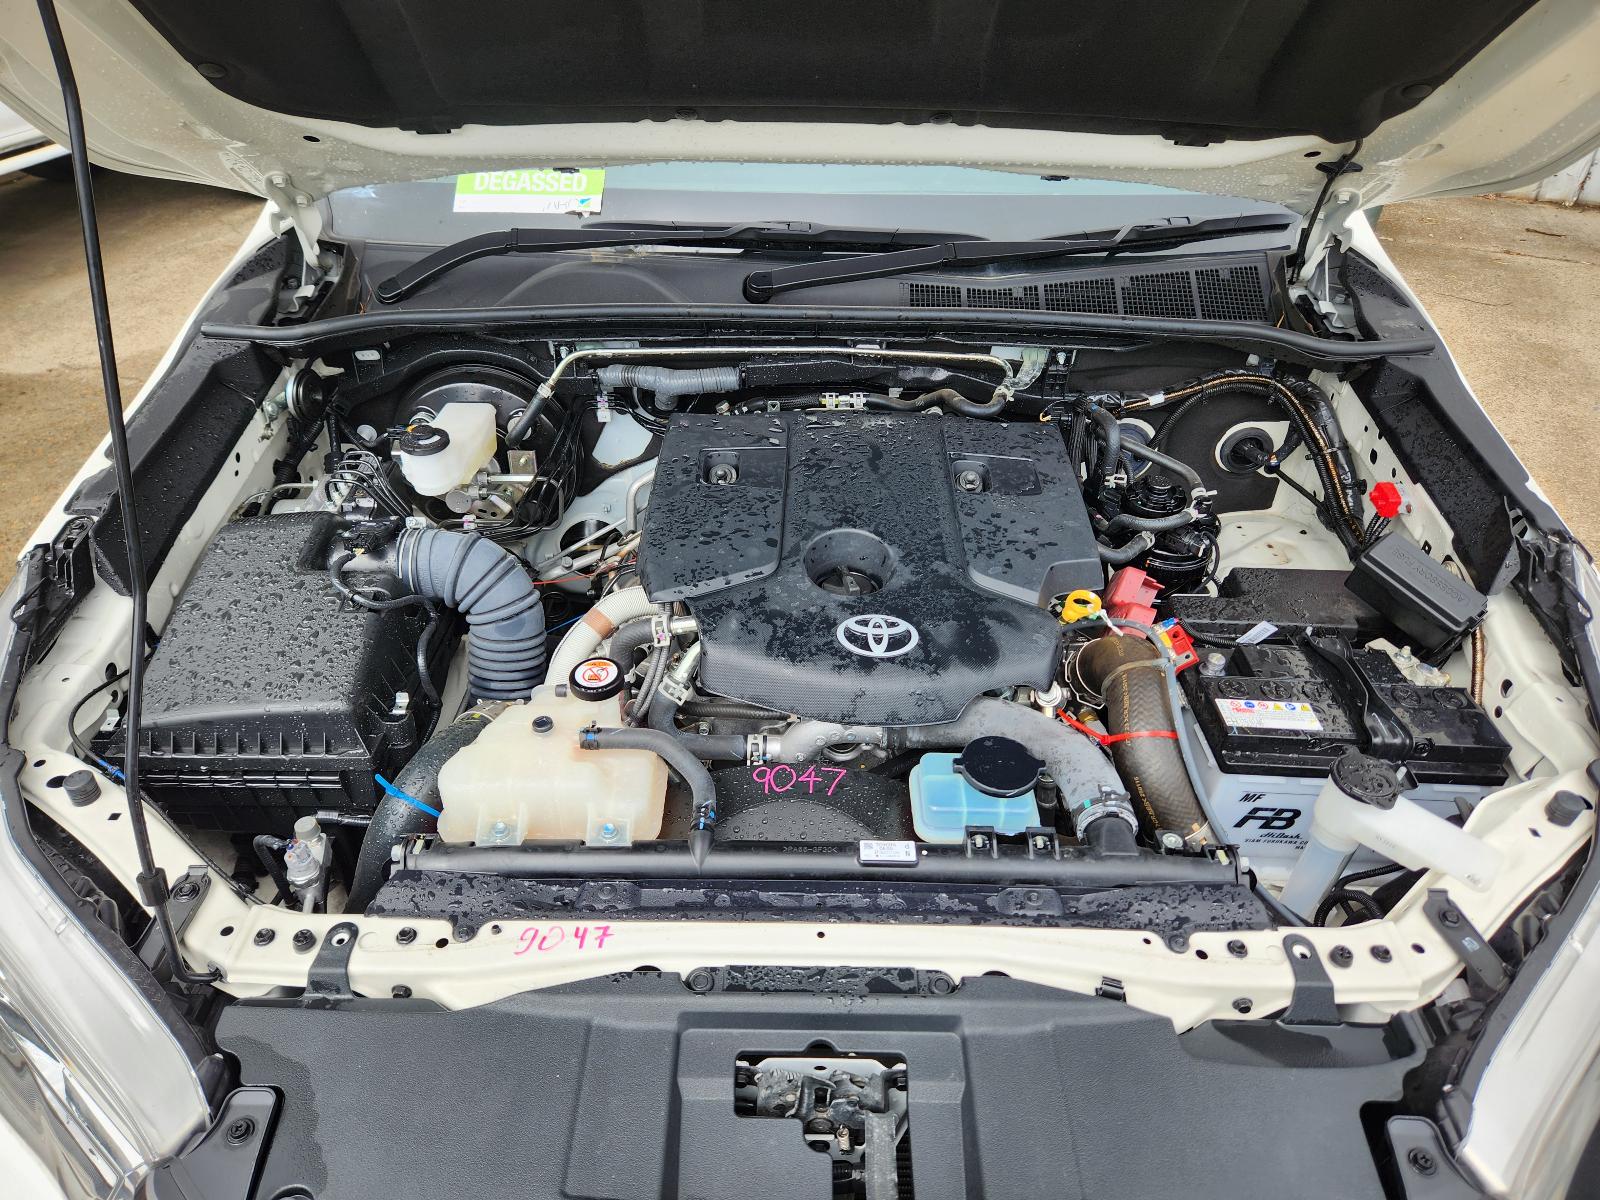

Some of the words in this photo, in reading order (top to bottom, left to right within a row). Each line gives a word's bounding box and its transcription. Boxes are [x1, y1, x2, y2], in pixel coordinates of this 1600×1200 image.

[473, 172, 588, 193] DEGASSED
[752, 764, 847, 796] 9047
[1239, 793, 1267, 803] MF
[1233, 806, 1302, 830] FB
[513, 924, 616, 956] 9047
